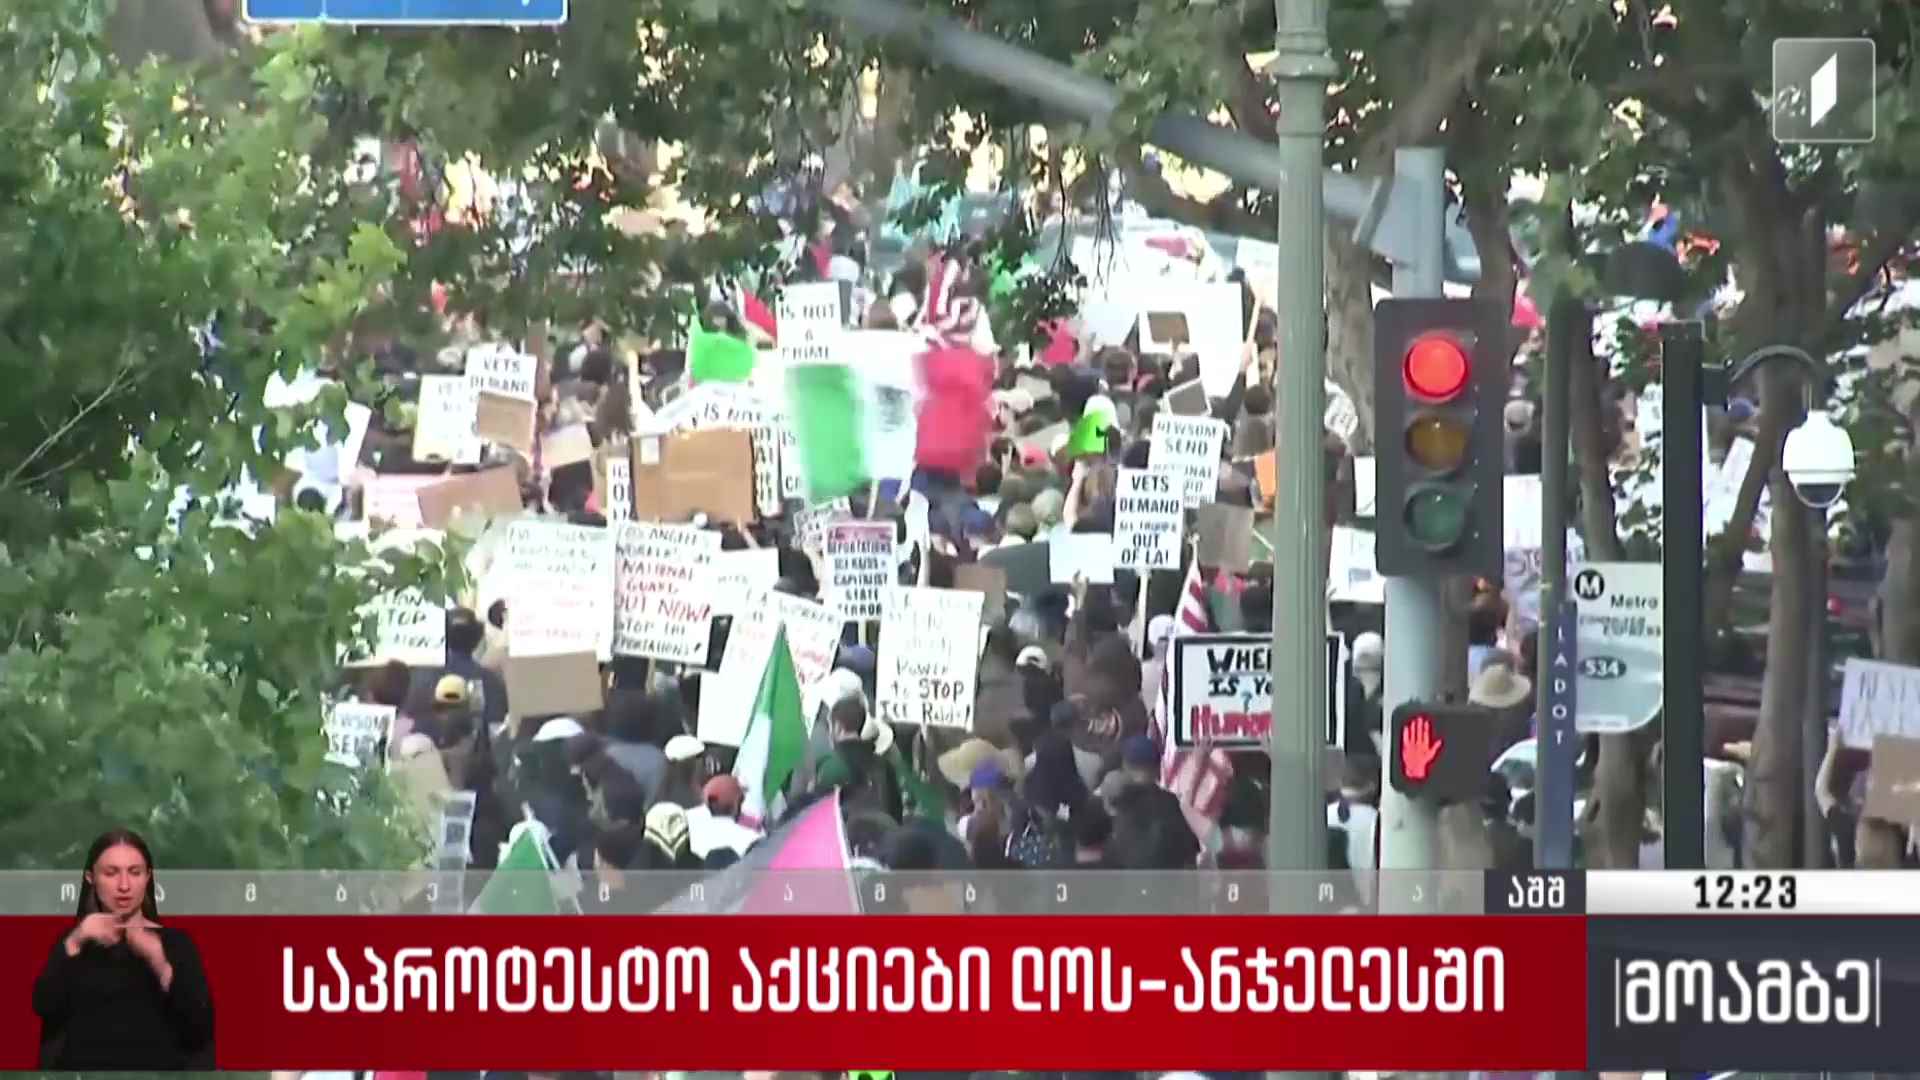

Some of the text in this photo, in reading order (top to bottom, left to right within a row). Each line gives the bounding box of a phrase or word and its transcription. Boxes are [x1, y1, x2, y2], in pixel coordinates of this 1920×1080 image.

[1132, 474, 1169, 493] VETS
[1119, 498, 1180, 514] DEMAND
[1132, 533, 1160, 549] OUT
[1121, 548, 1139, 565] OF
[1610, 594, 1659, 609] Metro
[1585, 659, 1619, 675] 534
[1208, 675, 1240, 697] IS
[1553, 626, 1569, 745] LADOT
